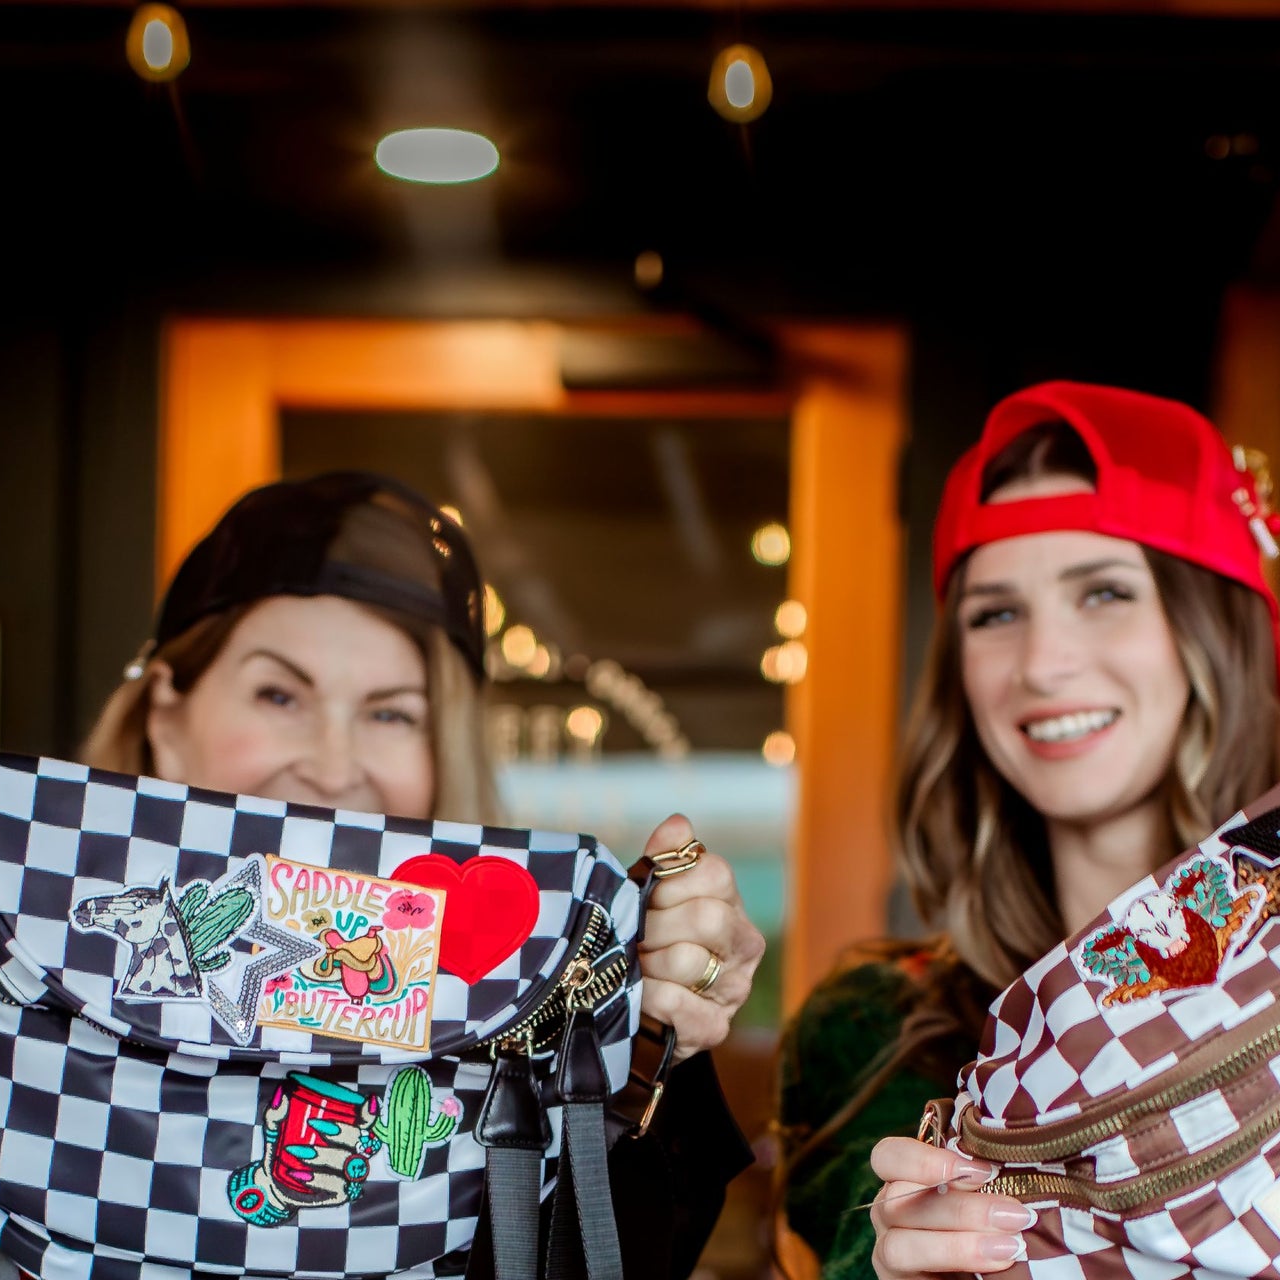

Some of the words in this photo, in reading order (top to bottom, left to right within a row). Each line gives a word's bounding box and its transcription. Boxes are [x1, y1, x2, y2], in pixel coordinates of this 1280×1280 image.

[268, 863, 391, 920] SADDLE
[336, 911, 368, 939] UP
[284, 988, 429, 1043] BUTTERCUP
